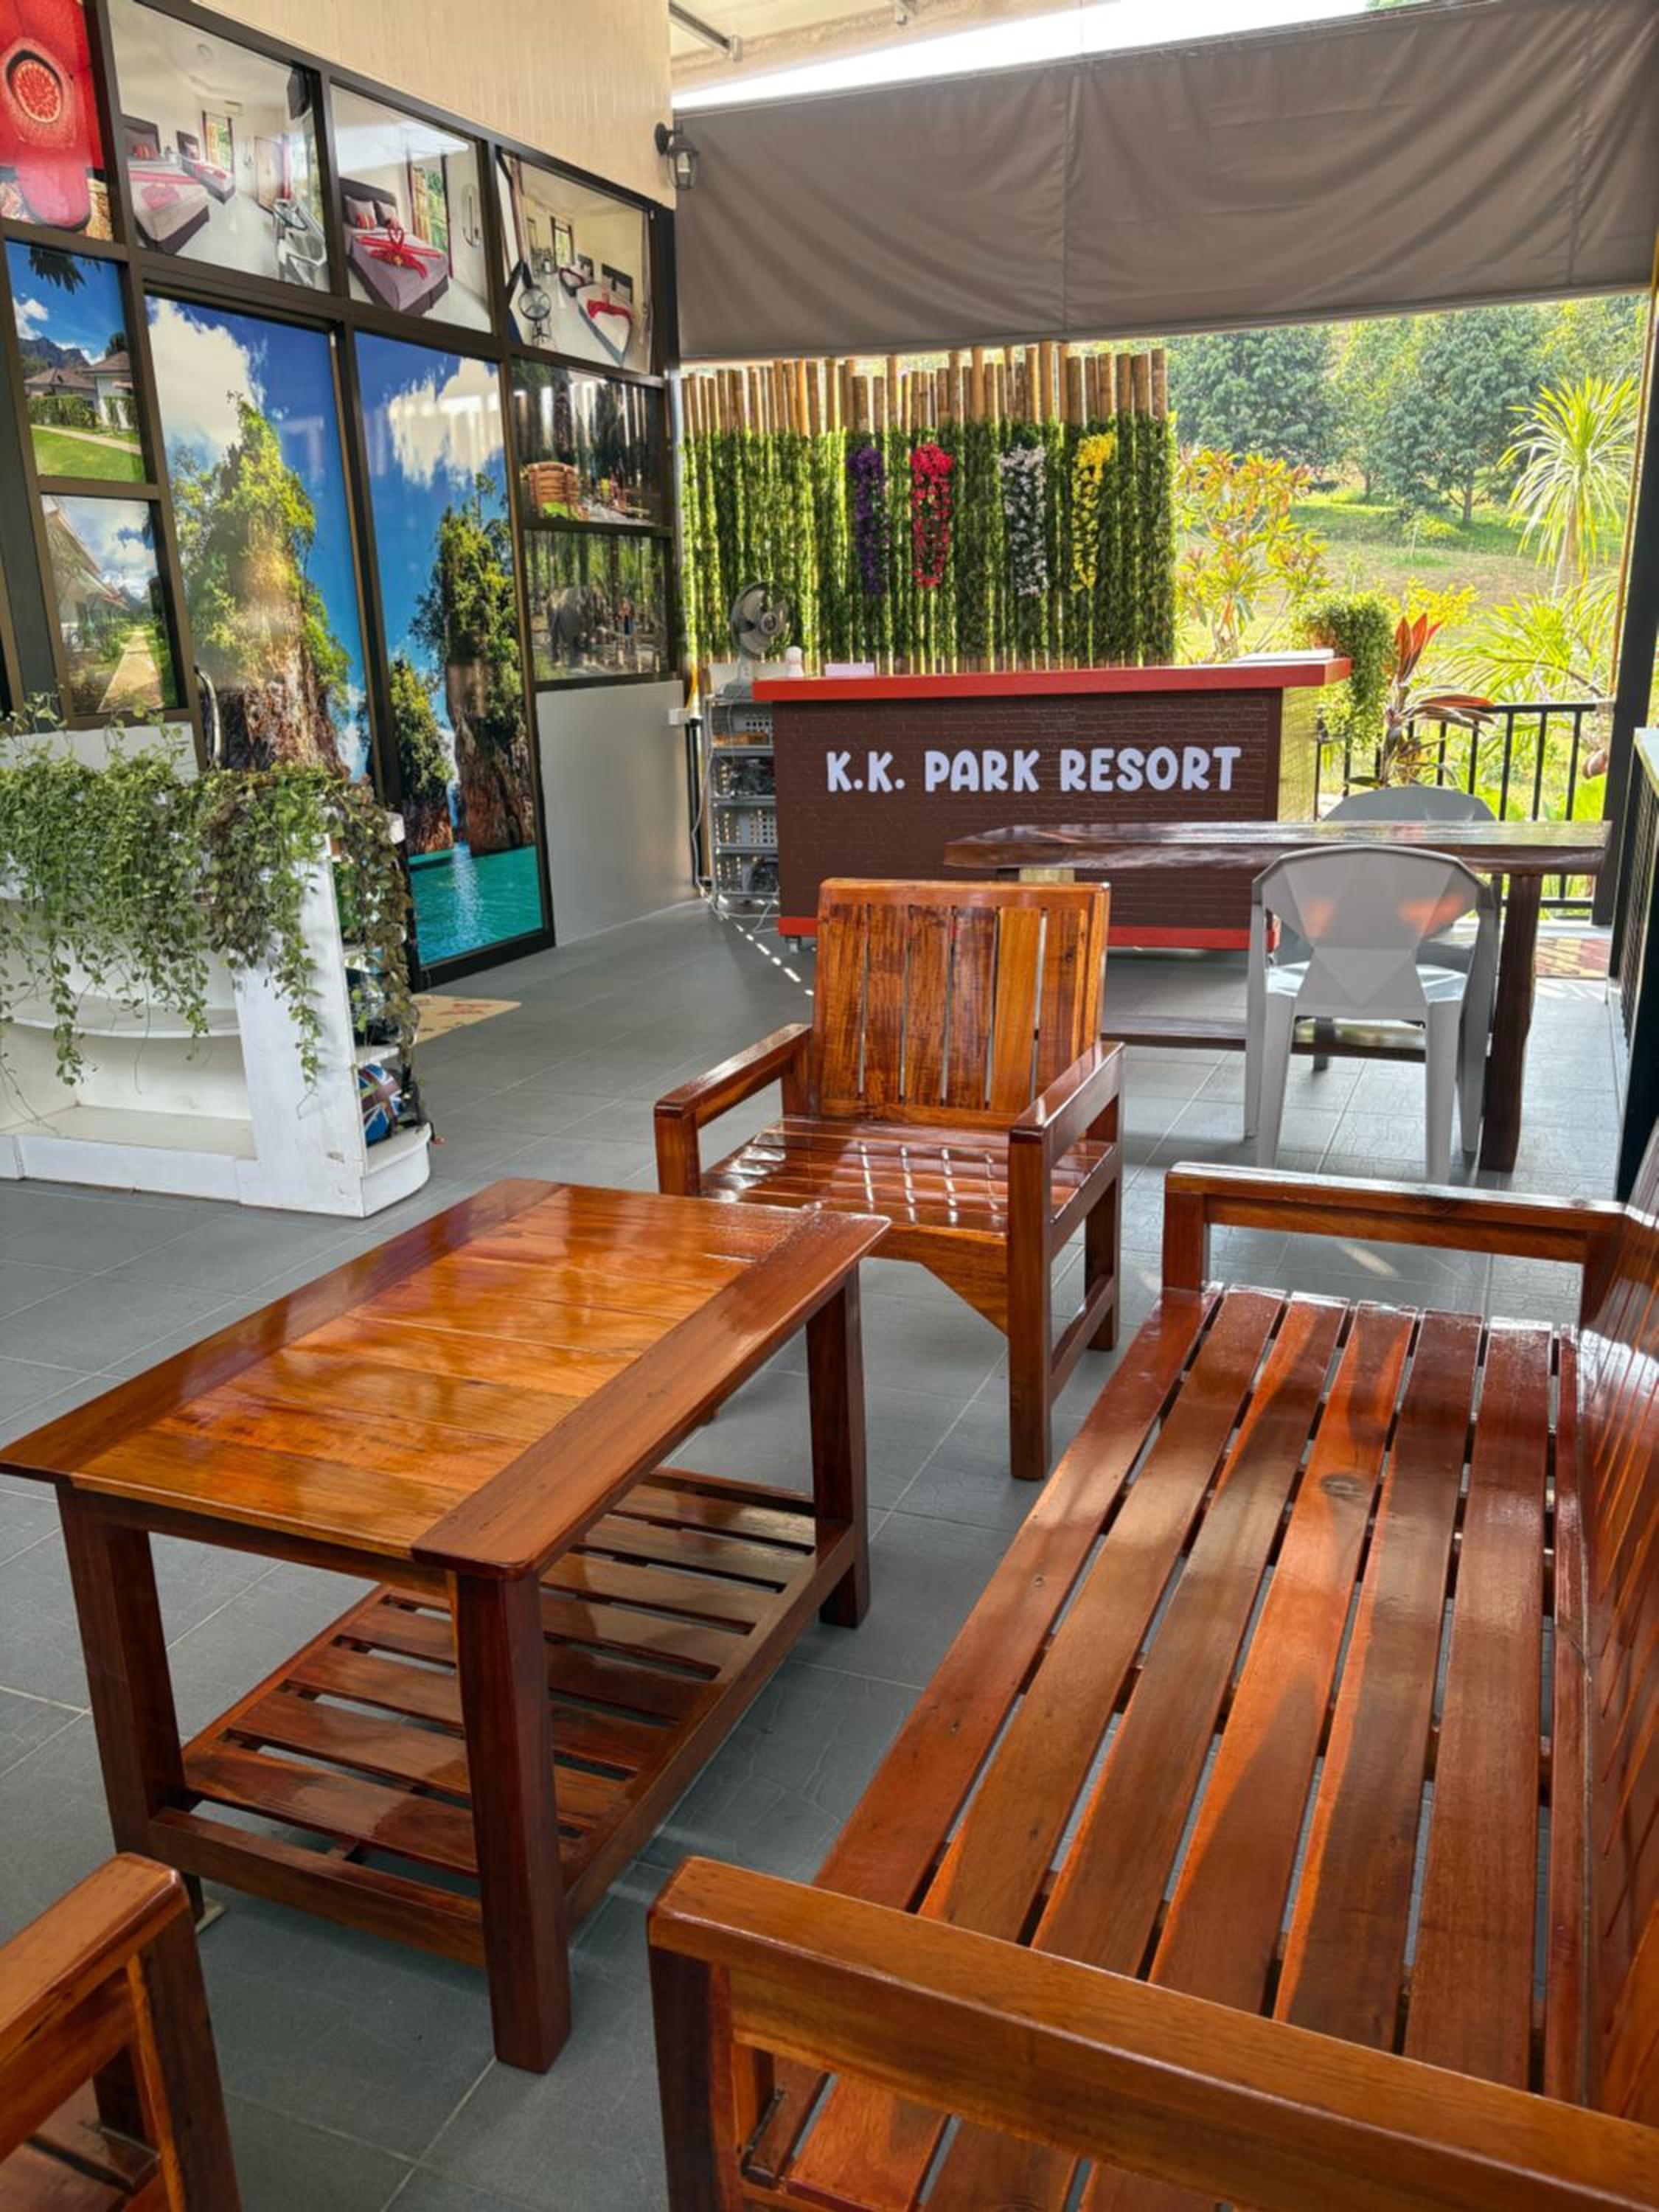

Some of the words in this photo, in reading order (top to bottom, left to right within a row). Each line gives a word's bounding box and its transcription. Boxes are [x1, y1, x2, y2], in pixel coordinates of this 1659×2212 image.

[826, 750, 905, 793] K.K.
[924, 749, 1040, 793] PARK
[1060, 745, 1242, 793] RESORT
